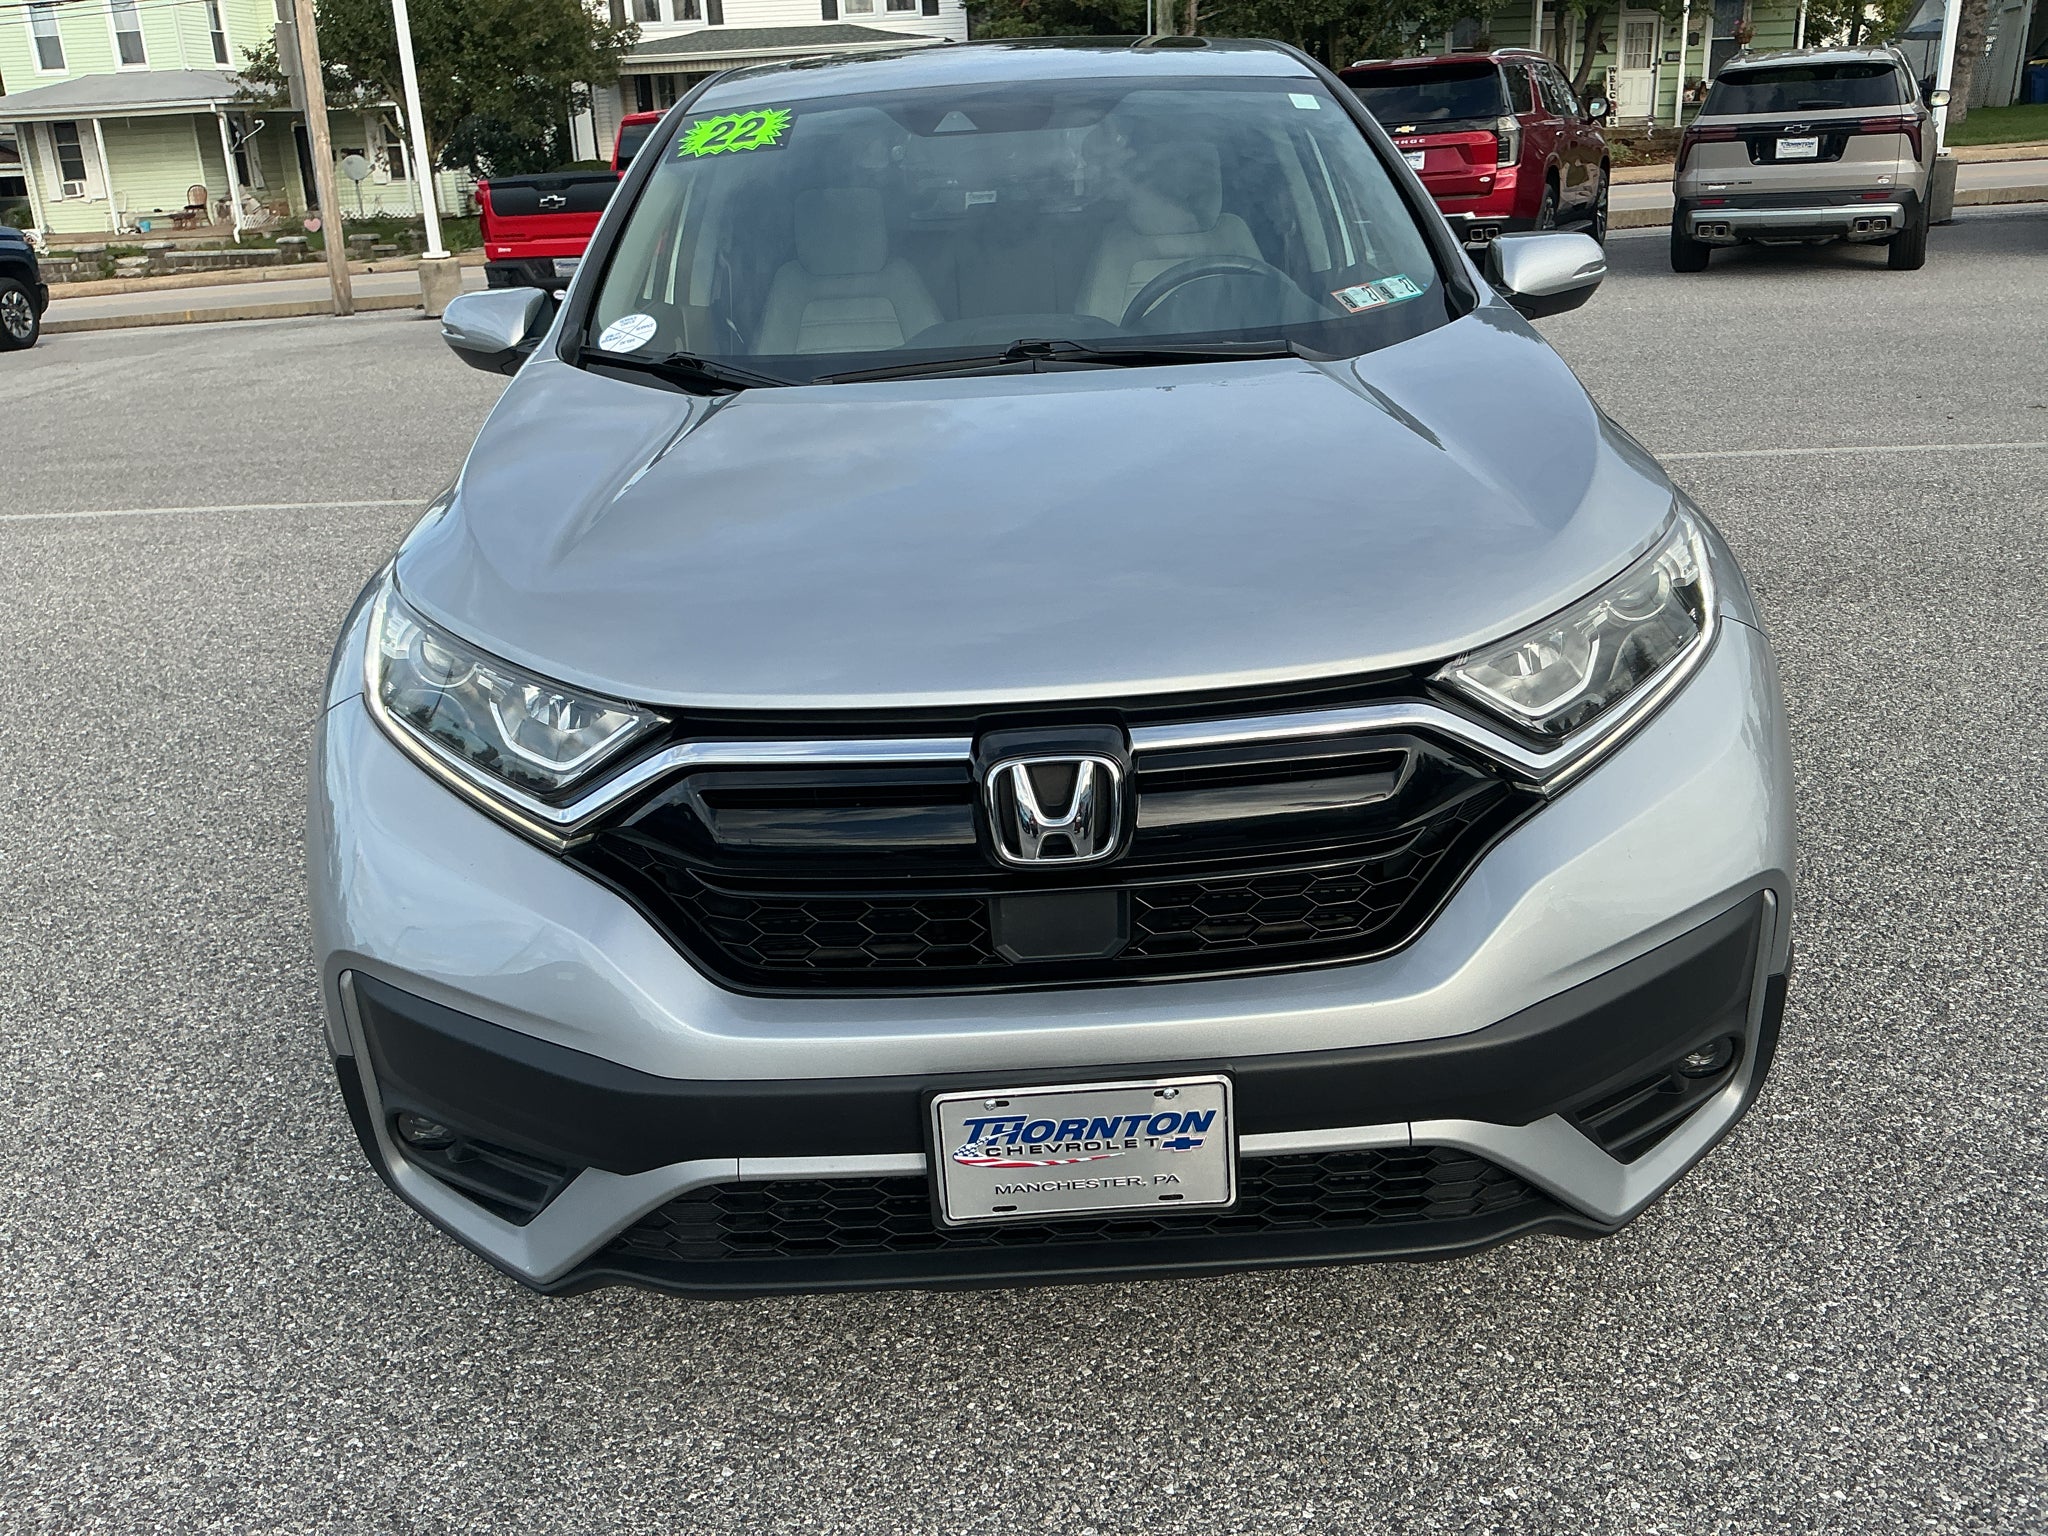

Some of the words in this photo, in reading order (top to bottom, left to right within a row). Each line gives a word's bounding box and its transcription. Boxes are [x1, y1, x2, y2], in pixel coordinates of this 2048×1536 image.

[700, 116, 767, 149] 22
[962, 1109, 1218, 1146] THORNTON
[985, 1137, 1160, 1157] CHEVROLET
[994, 1175, 1147, 1195] MANCHESTER,
[1154, 1173, 1180, 1185] PA
